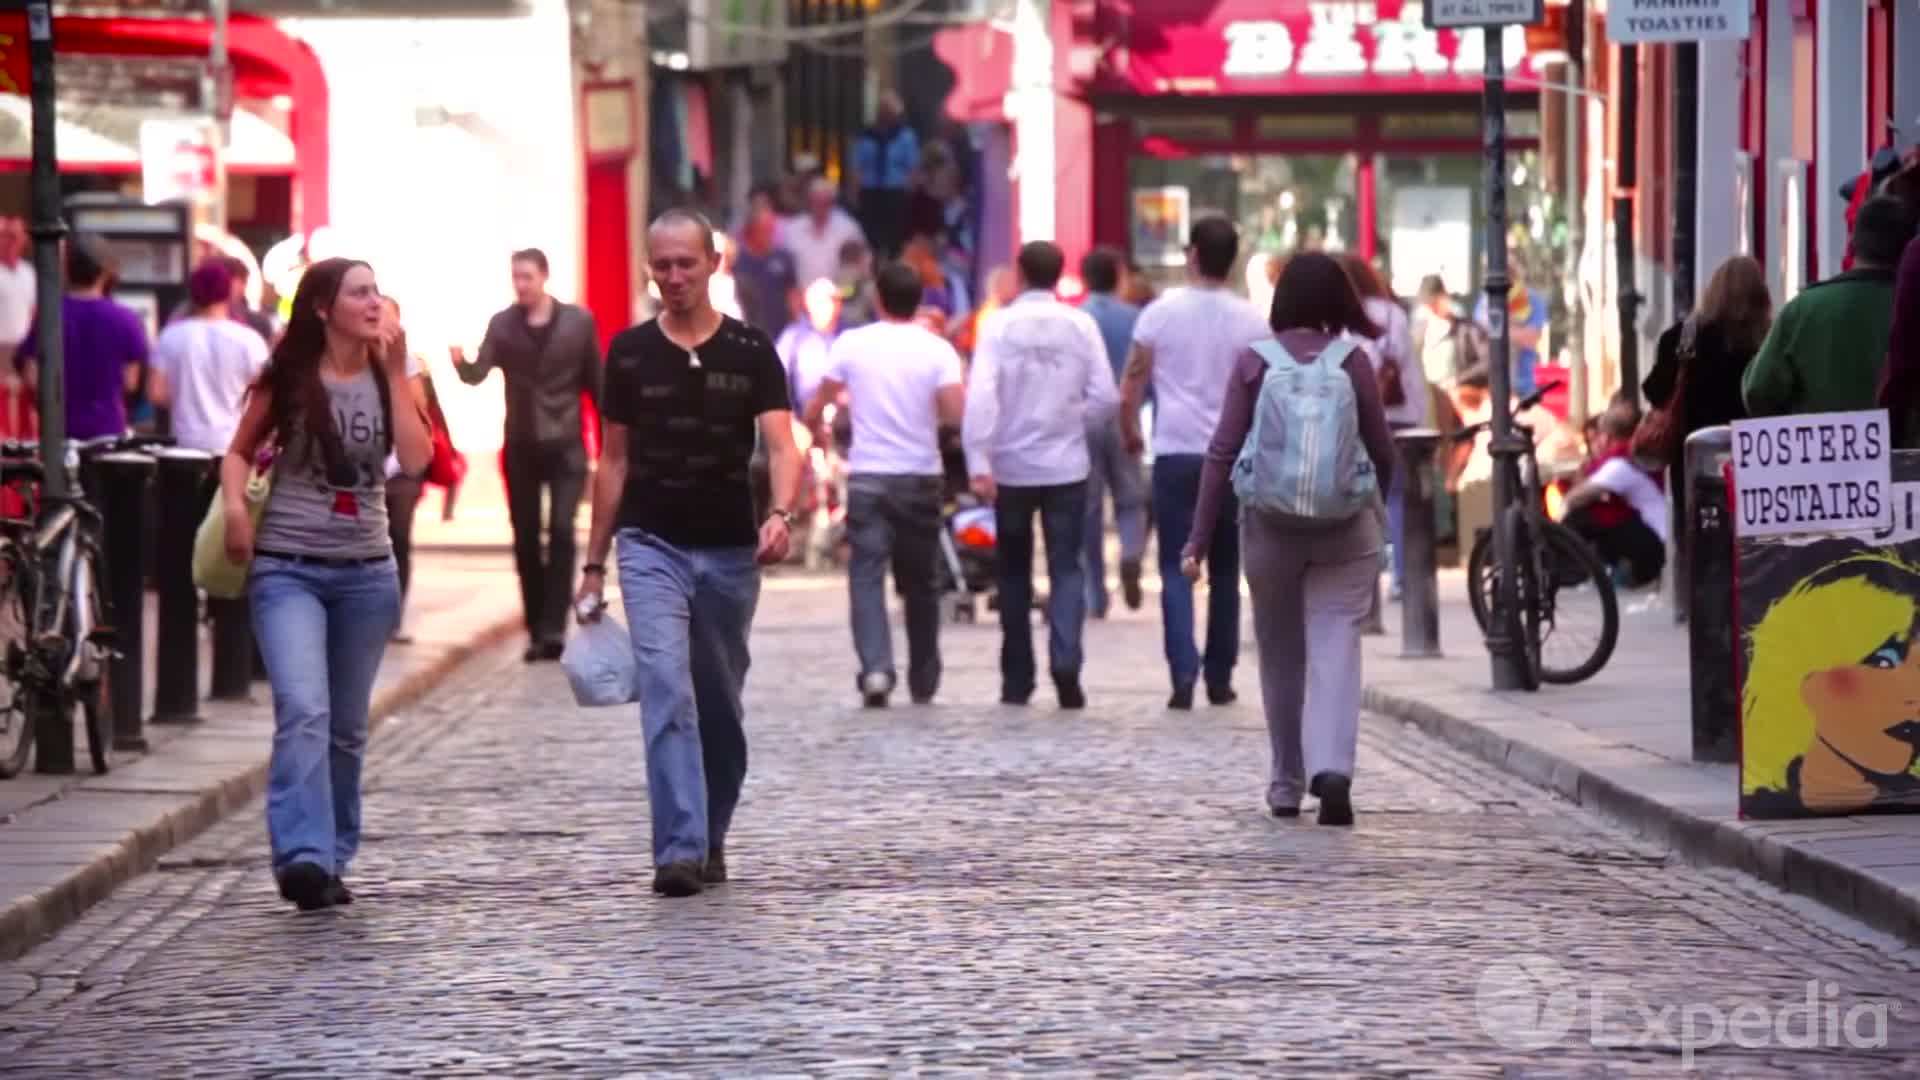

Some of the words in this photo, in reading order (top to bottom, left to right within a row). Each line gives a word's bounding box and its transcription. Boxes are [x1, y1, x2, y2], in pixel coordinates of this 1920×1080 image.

[1461, 4, 1482, 15] ALL
[1489, 3, 1526, 14] TIMES
[1625, 15, 1728, 32] TOASTIES
[1738, 421, 1881, 468] POSTERS
[1741, 480, 1881, 526] UPSTAIRS
